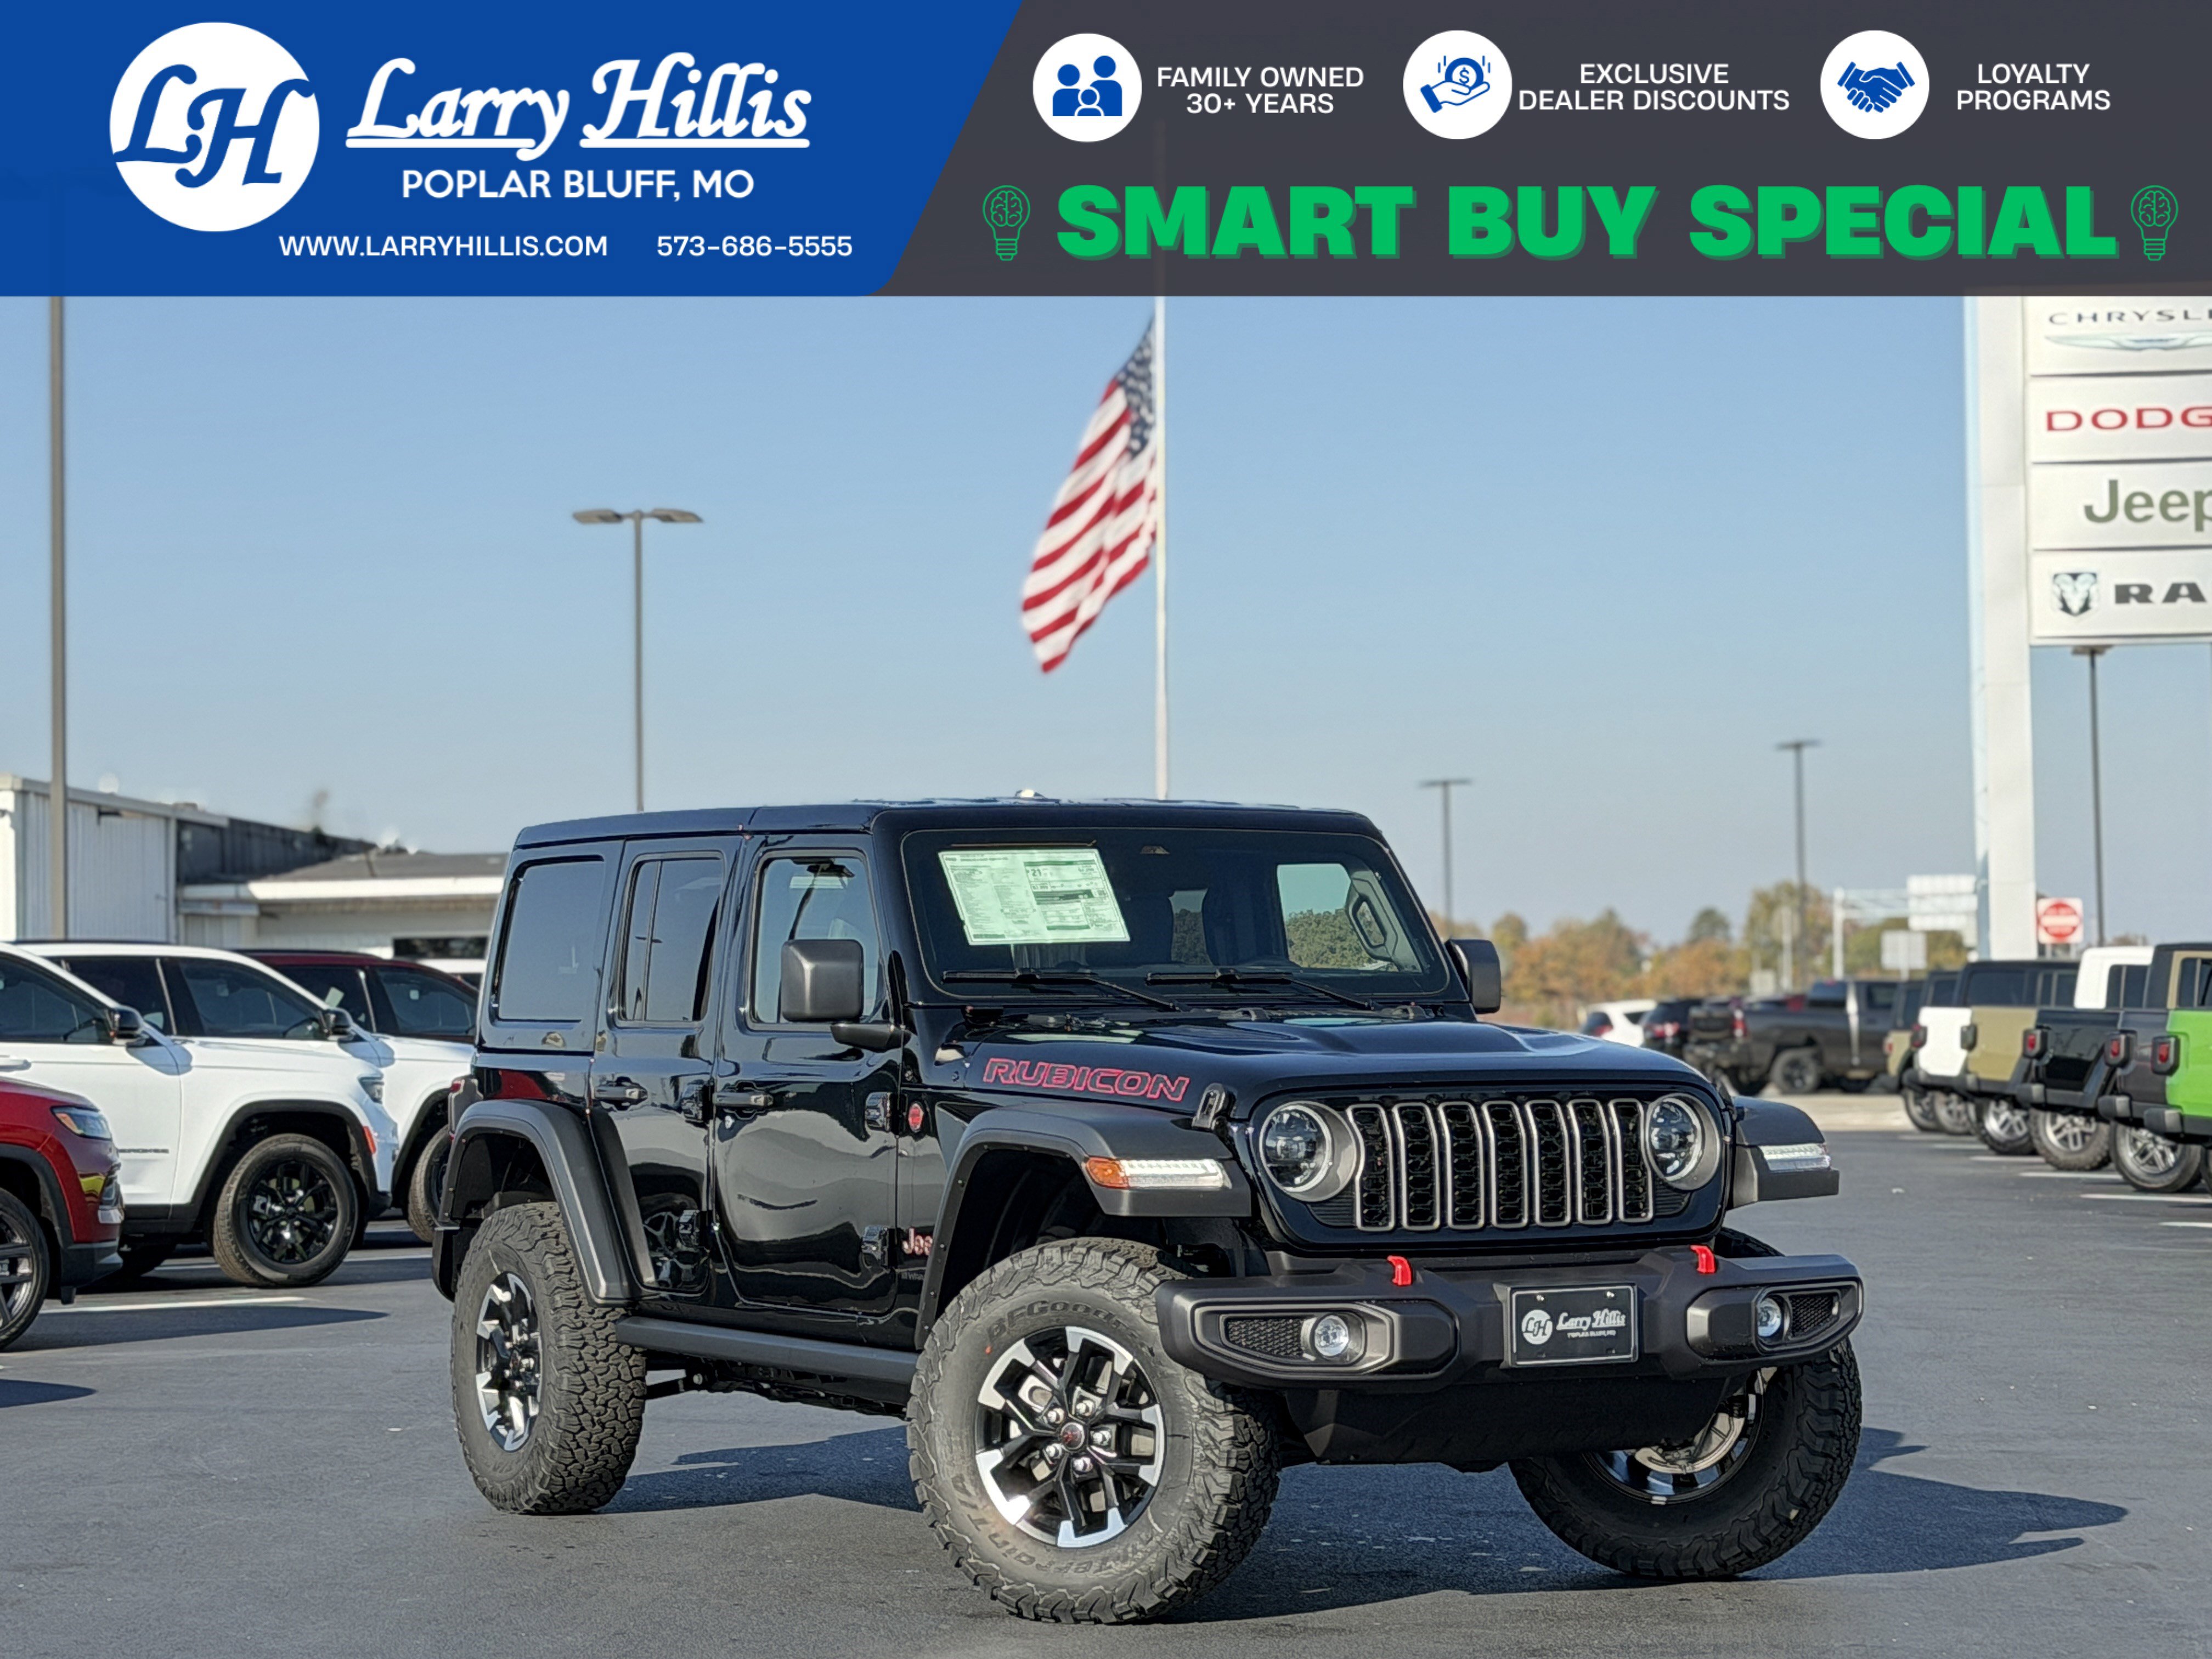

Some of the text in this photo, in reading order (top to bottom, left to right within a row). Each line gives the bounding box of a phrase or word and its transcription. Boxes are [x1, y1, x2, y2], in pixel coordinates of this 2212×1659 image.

[2047, 406, 2212, 431] DODG
[2084, 479, 2212, 532] Jeep
[2115, 583, 2207, 604] RA
[983, 1058, 1190, 1102] RUBICON
[902, 1228, 933, 1256] Jee
